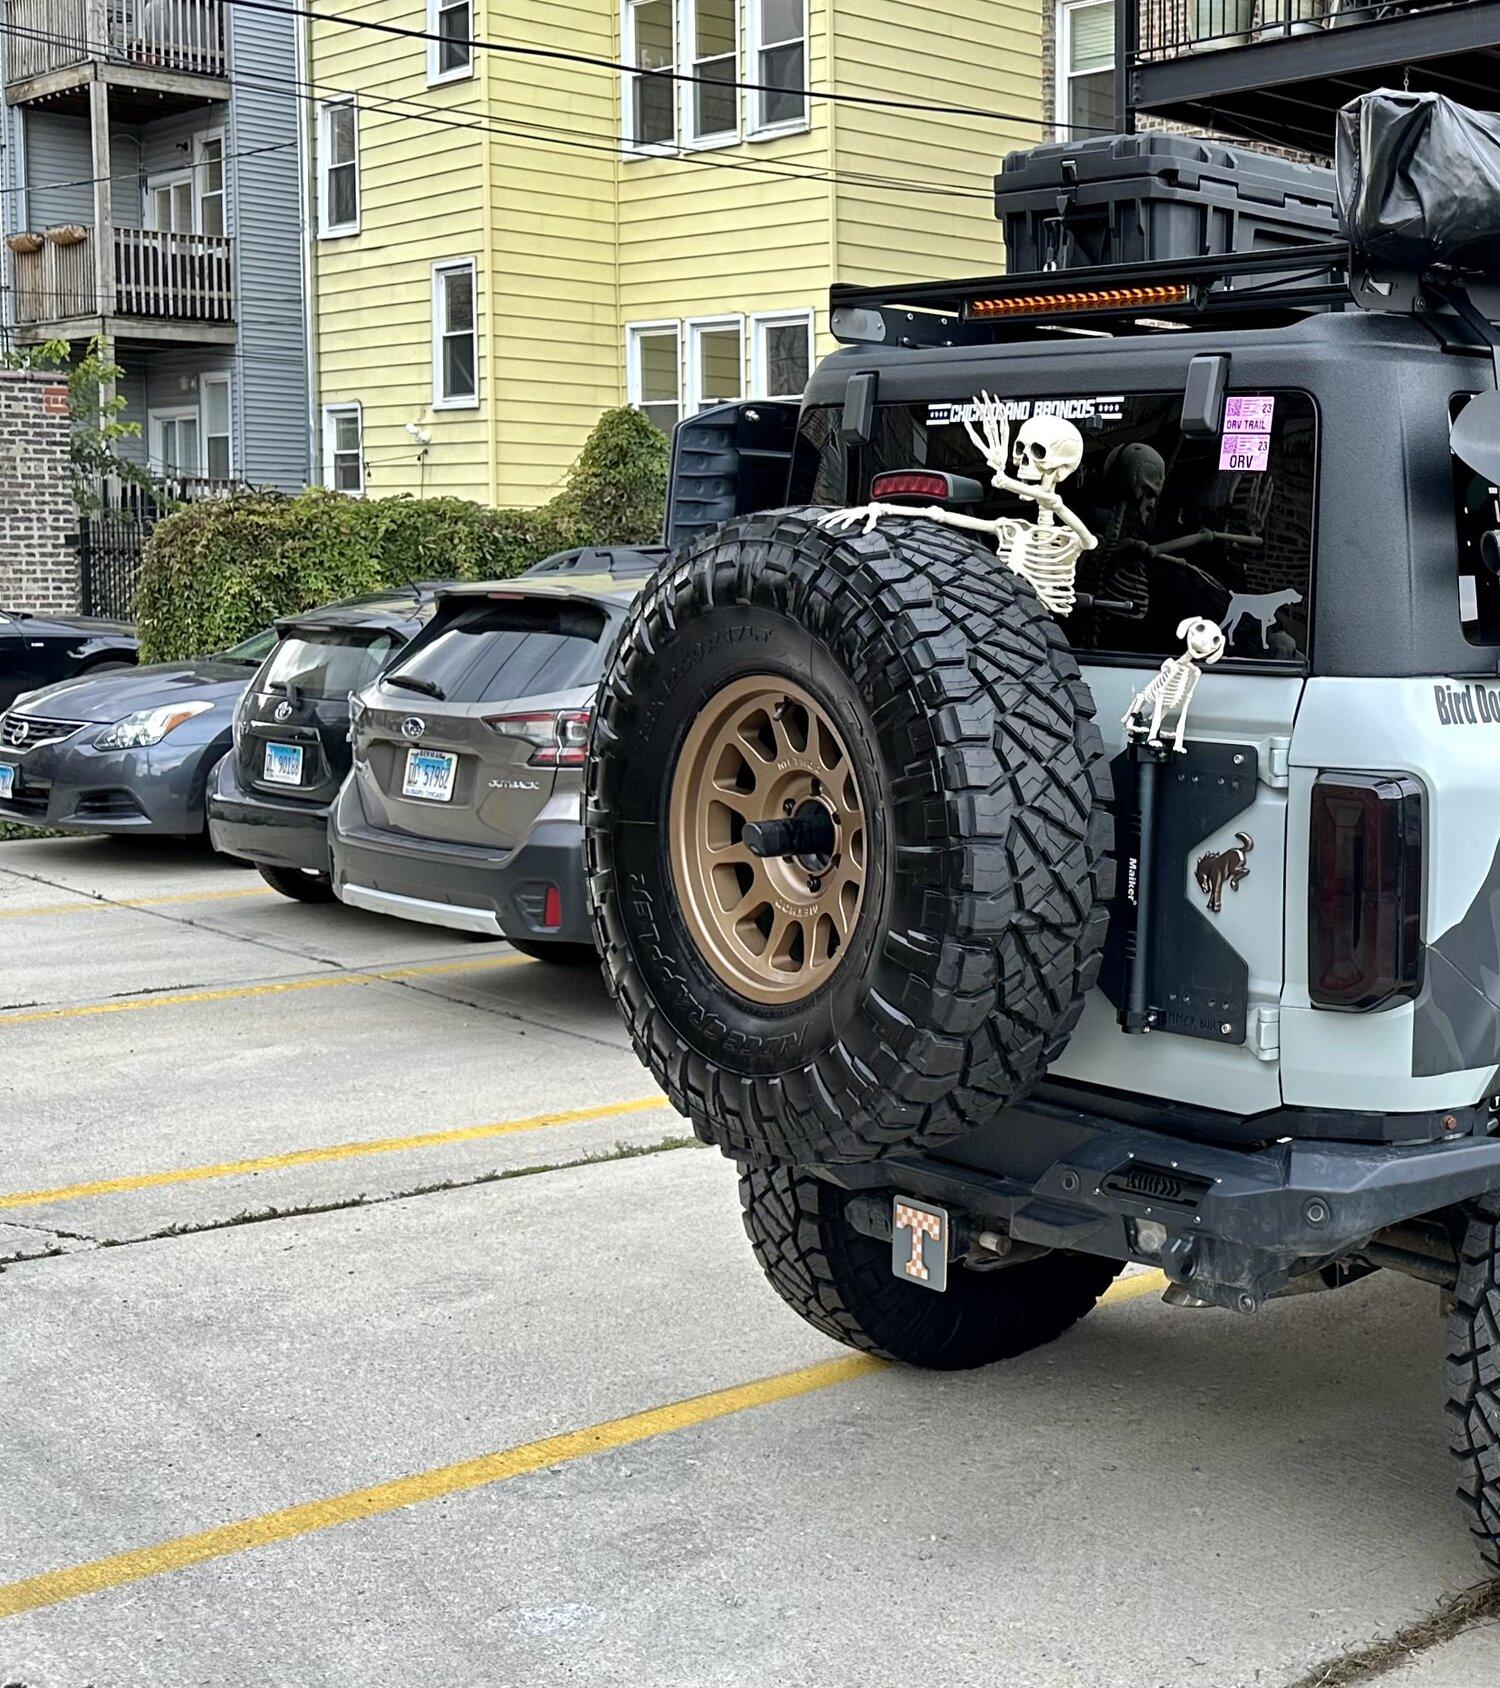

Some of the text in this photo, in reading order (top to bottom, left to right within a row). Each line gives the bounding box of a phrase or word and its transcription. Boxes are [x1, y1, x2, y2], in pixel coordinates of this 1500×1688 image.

[1034, 399, 1096, 419] BRONCOS
[1262, 403, 1272, 414] 23
[1226, 420, 1266, 430] ORV TRAIL
[1257, 441, 1268, 451] 23
[1229, 455, 1254, 468] ORV
[1434, 685, 1478, 725] Bird
[896, 1204, 941, 1280] T
